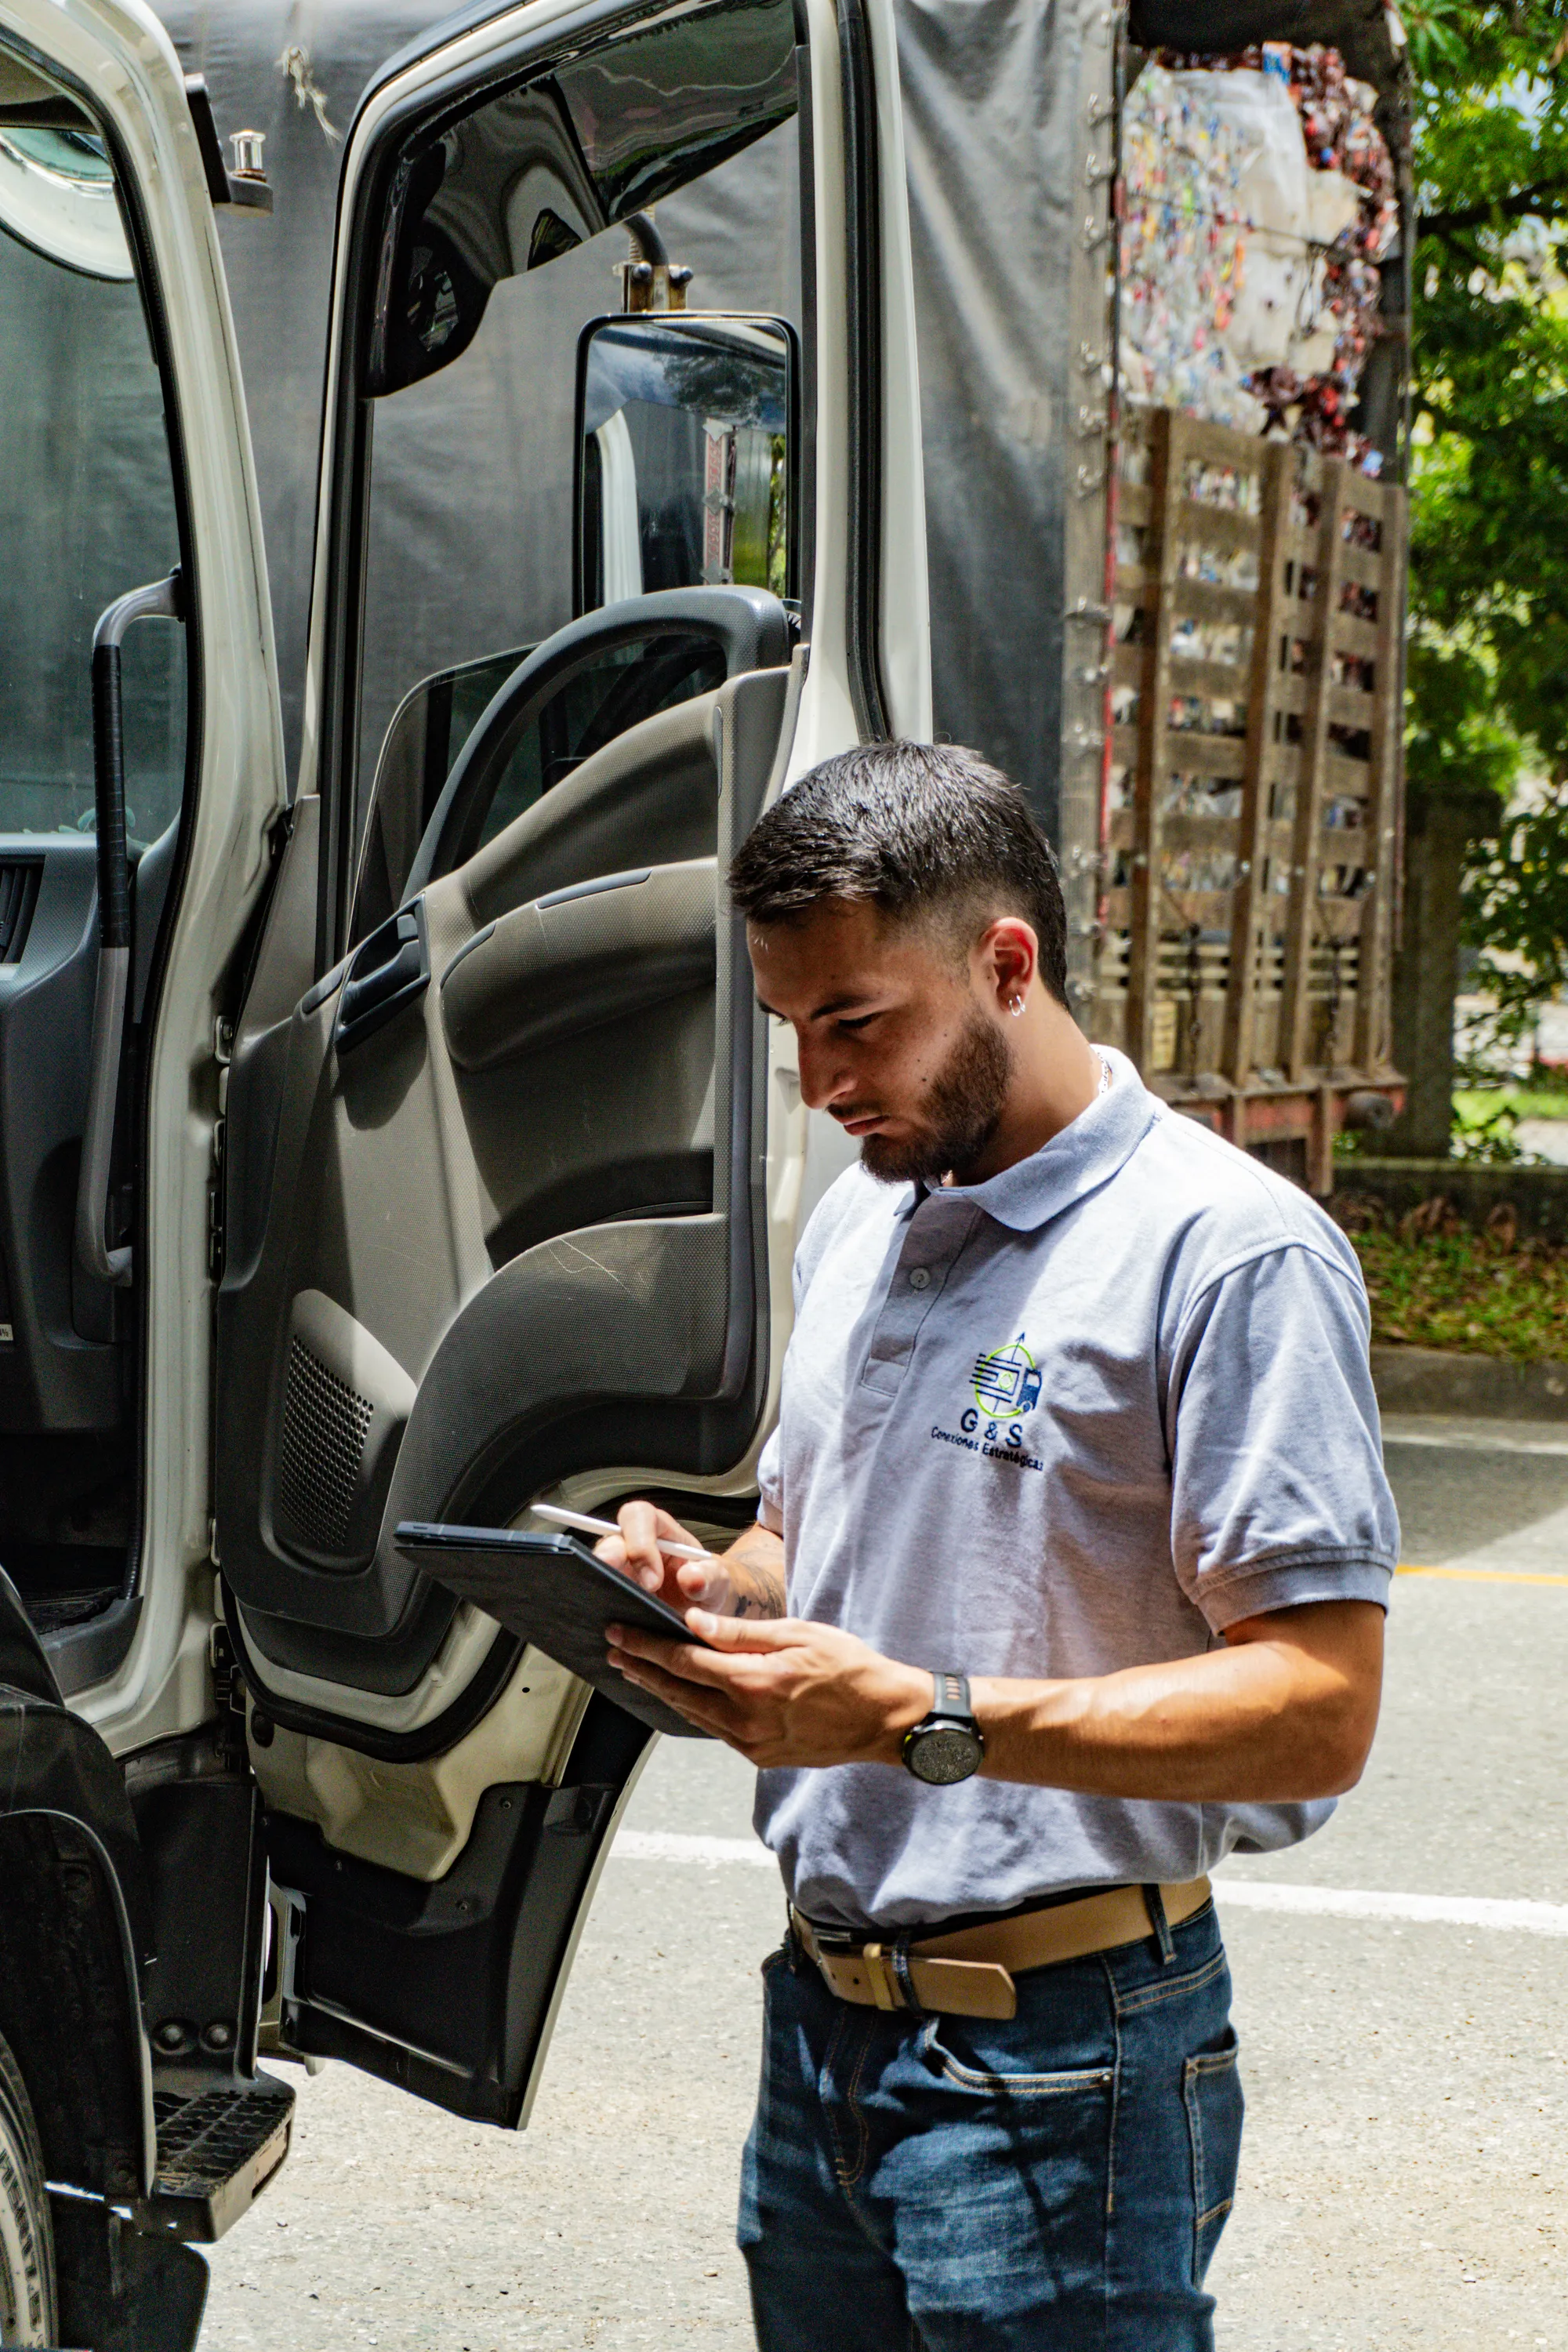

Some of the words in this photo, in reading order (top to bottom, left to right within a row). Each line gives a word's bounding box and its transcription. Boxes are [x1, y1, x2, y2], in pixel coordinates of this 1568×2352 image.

[931, 1427, 978, 1450] Conexiones
[960, 1408, 978, 1432] G
[984, 1421, 998, 1441] &
[1005, 1424, 1023, 1448] S
